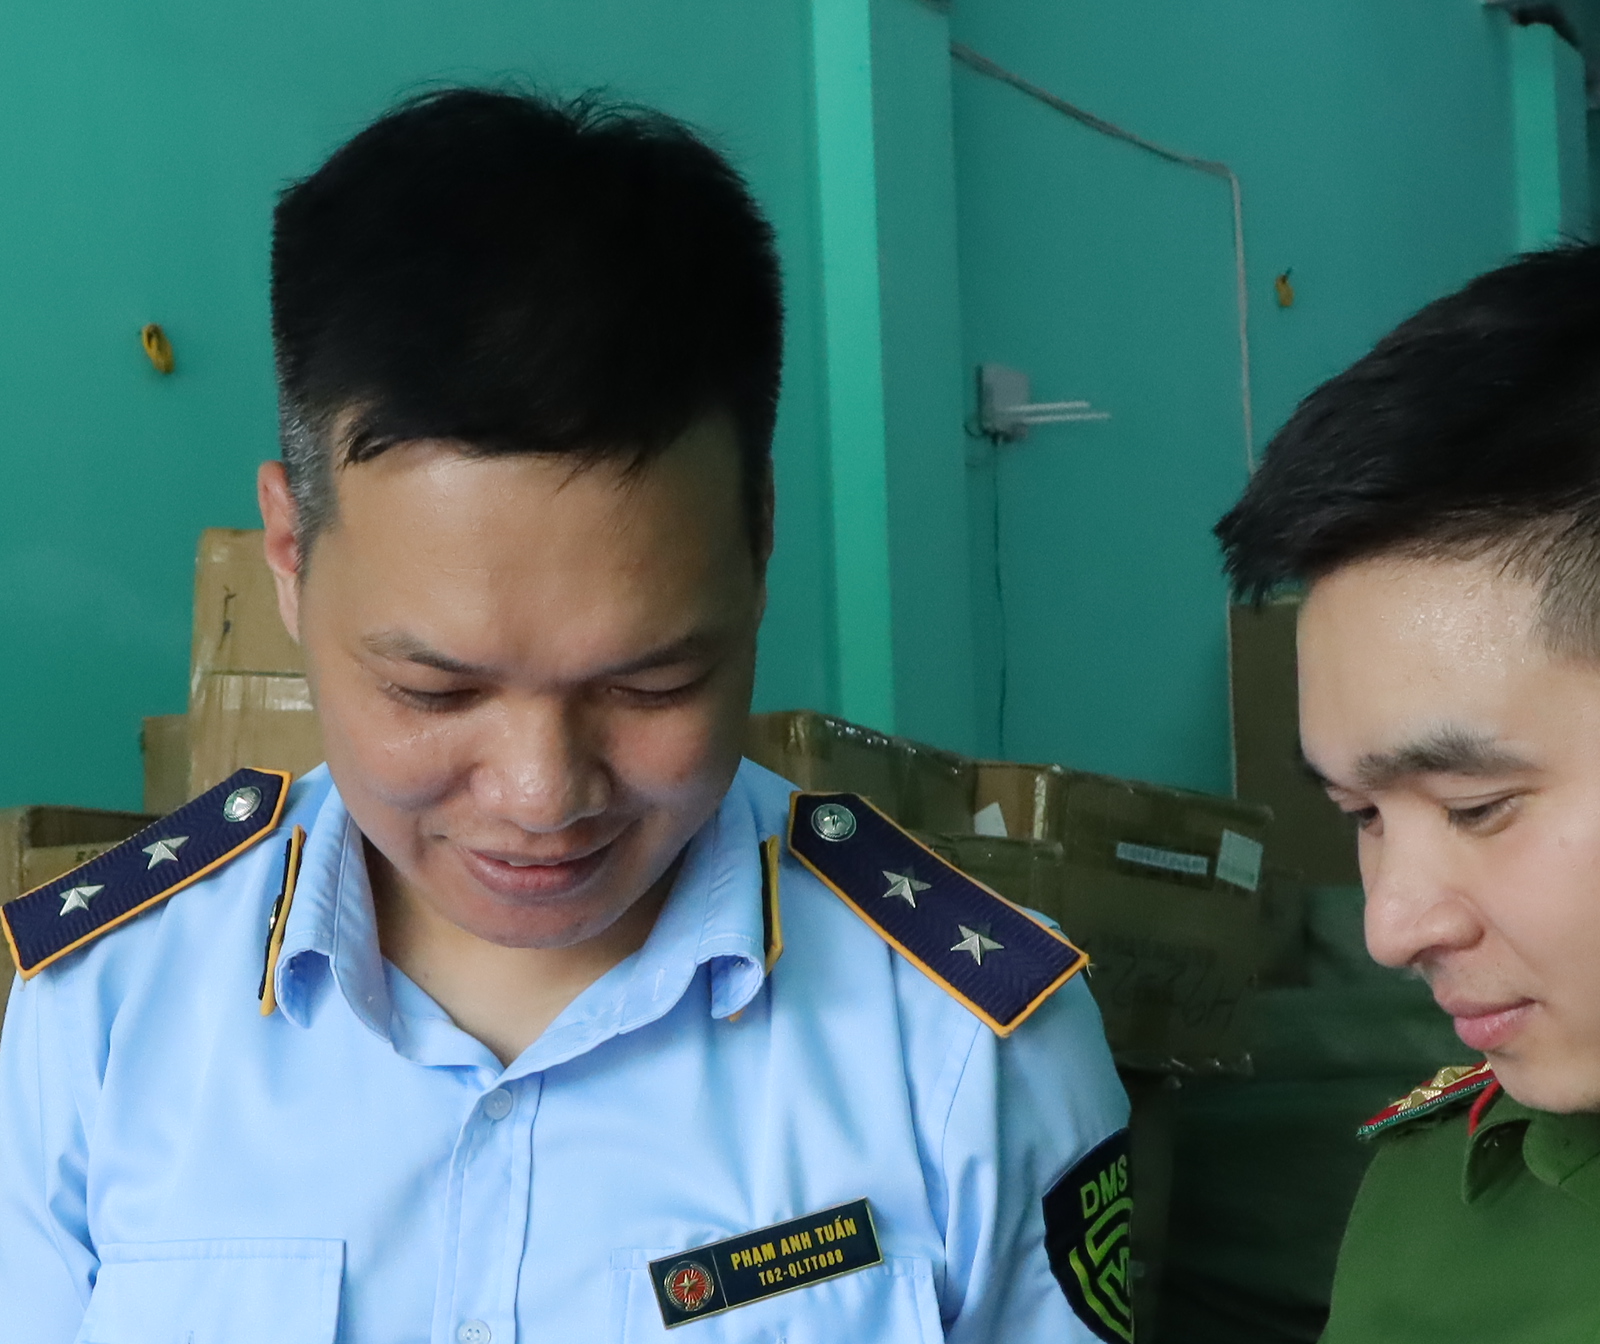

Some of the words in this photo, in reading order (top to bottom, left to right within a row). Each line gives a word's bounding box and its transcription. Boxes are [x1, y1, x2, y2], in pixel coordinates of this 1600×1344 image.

[1079, 1153, 1129, 1220] DMS
[730, 1241, 777, 1271] PHẠM
[780, 1231, 813, 1256] ANH
[813, 1214, 858, 1245] TUẤN
